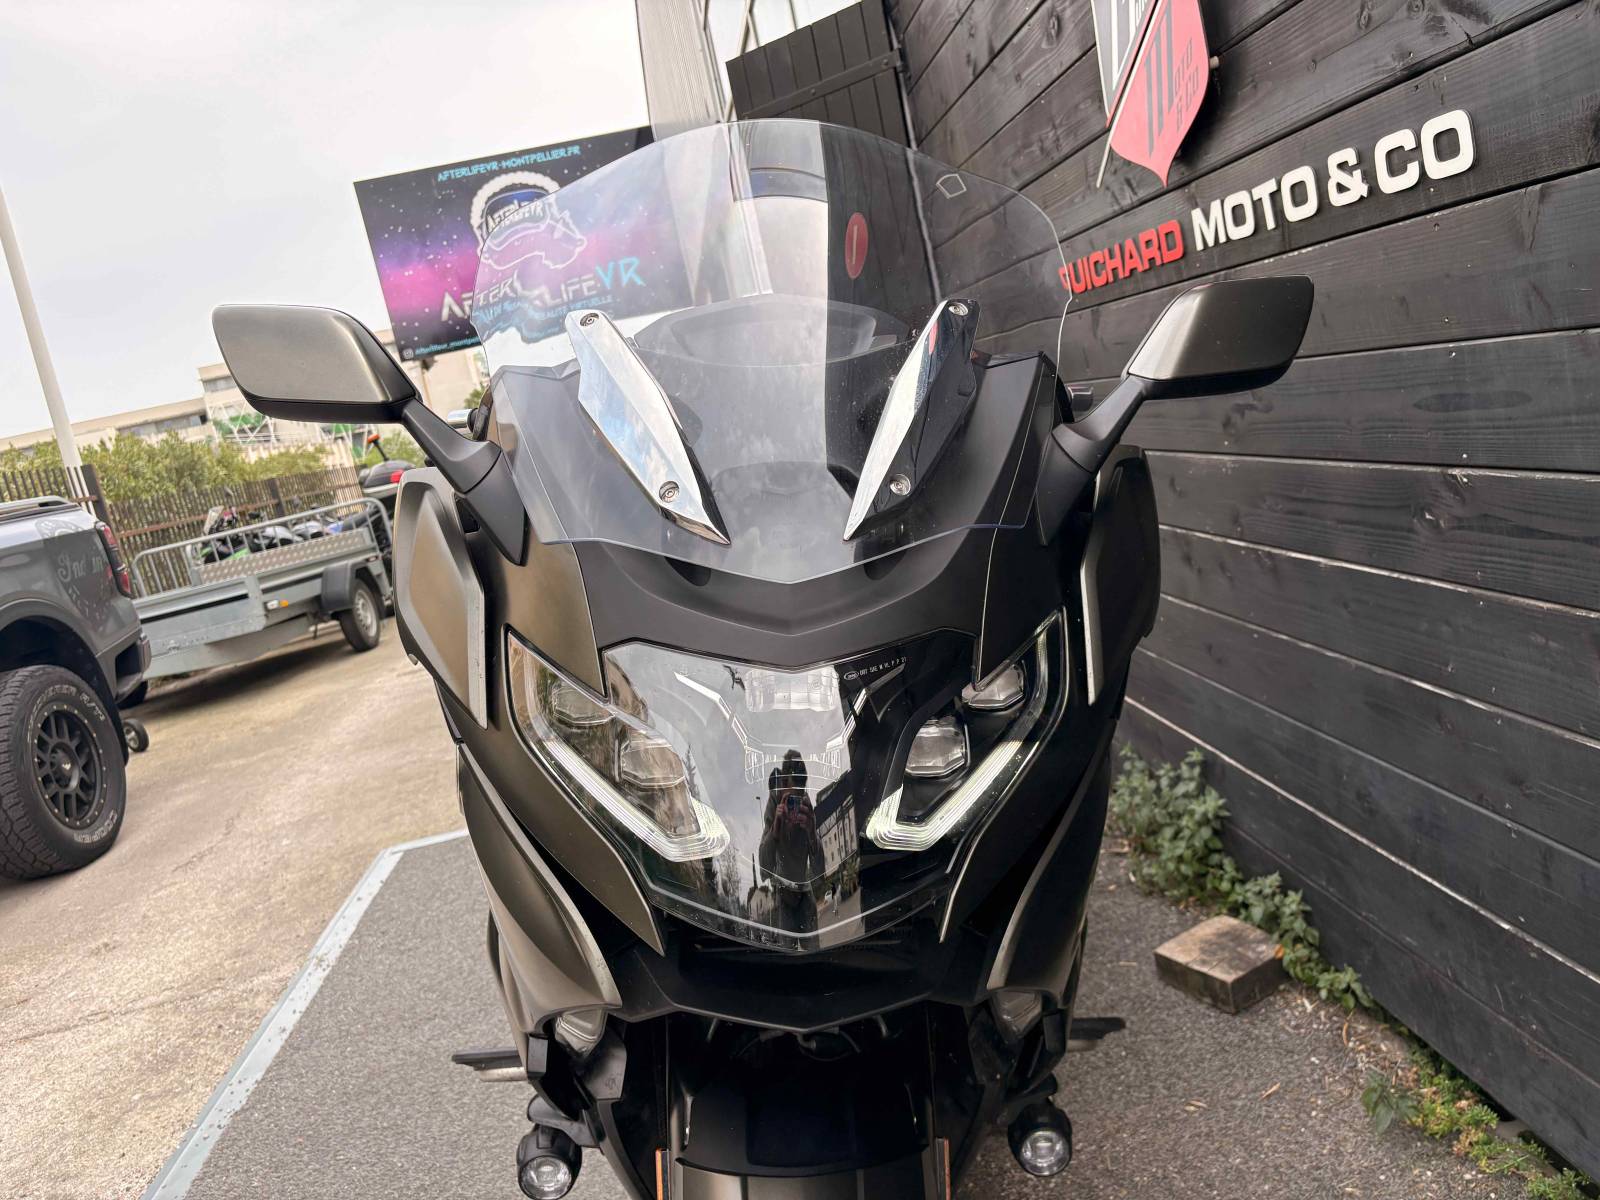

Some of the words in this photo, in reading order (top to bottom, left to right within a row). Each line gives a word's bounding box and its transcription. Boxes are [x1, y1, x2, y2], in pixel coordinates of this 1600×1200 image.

[1191, 166, 1319, 251] MOTO
[1327, 147, 1368, 207] &
[1374, 109, 1475, 194] CO
